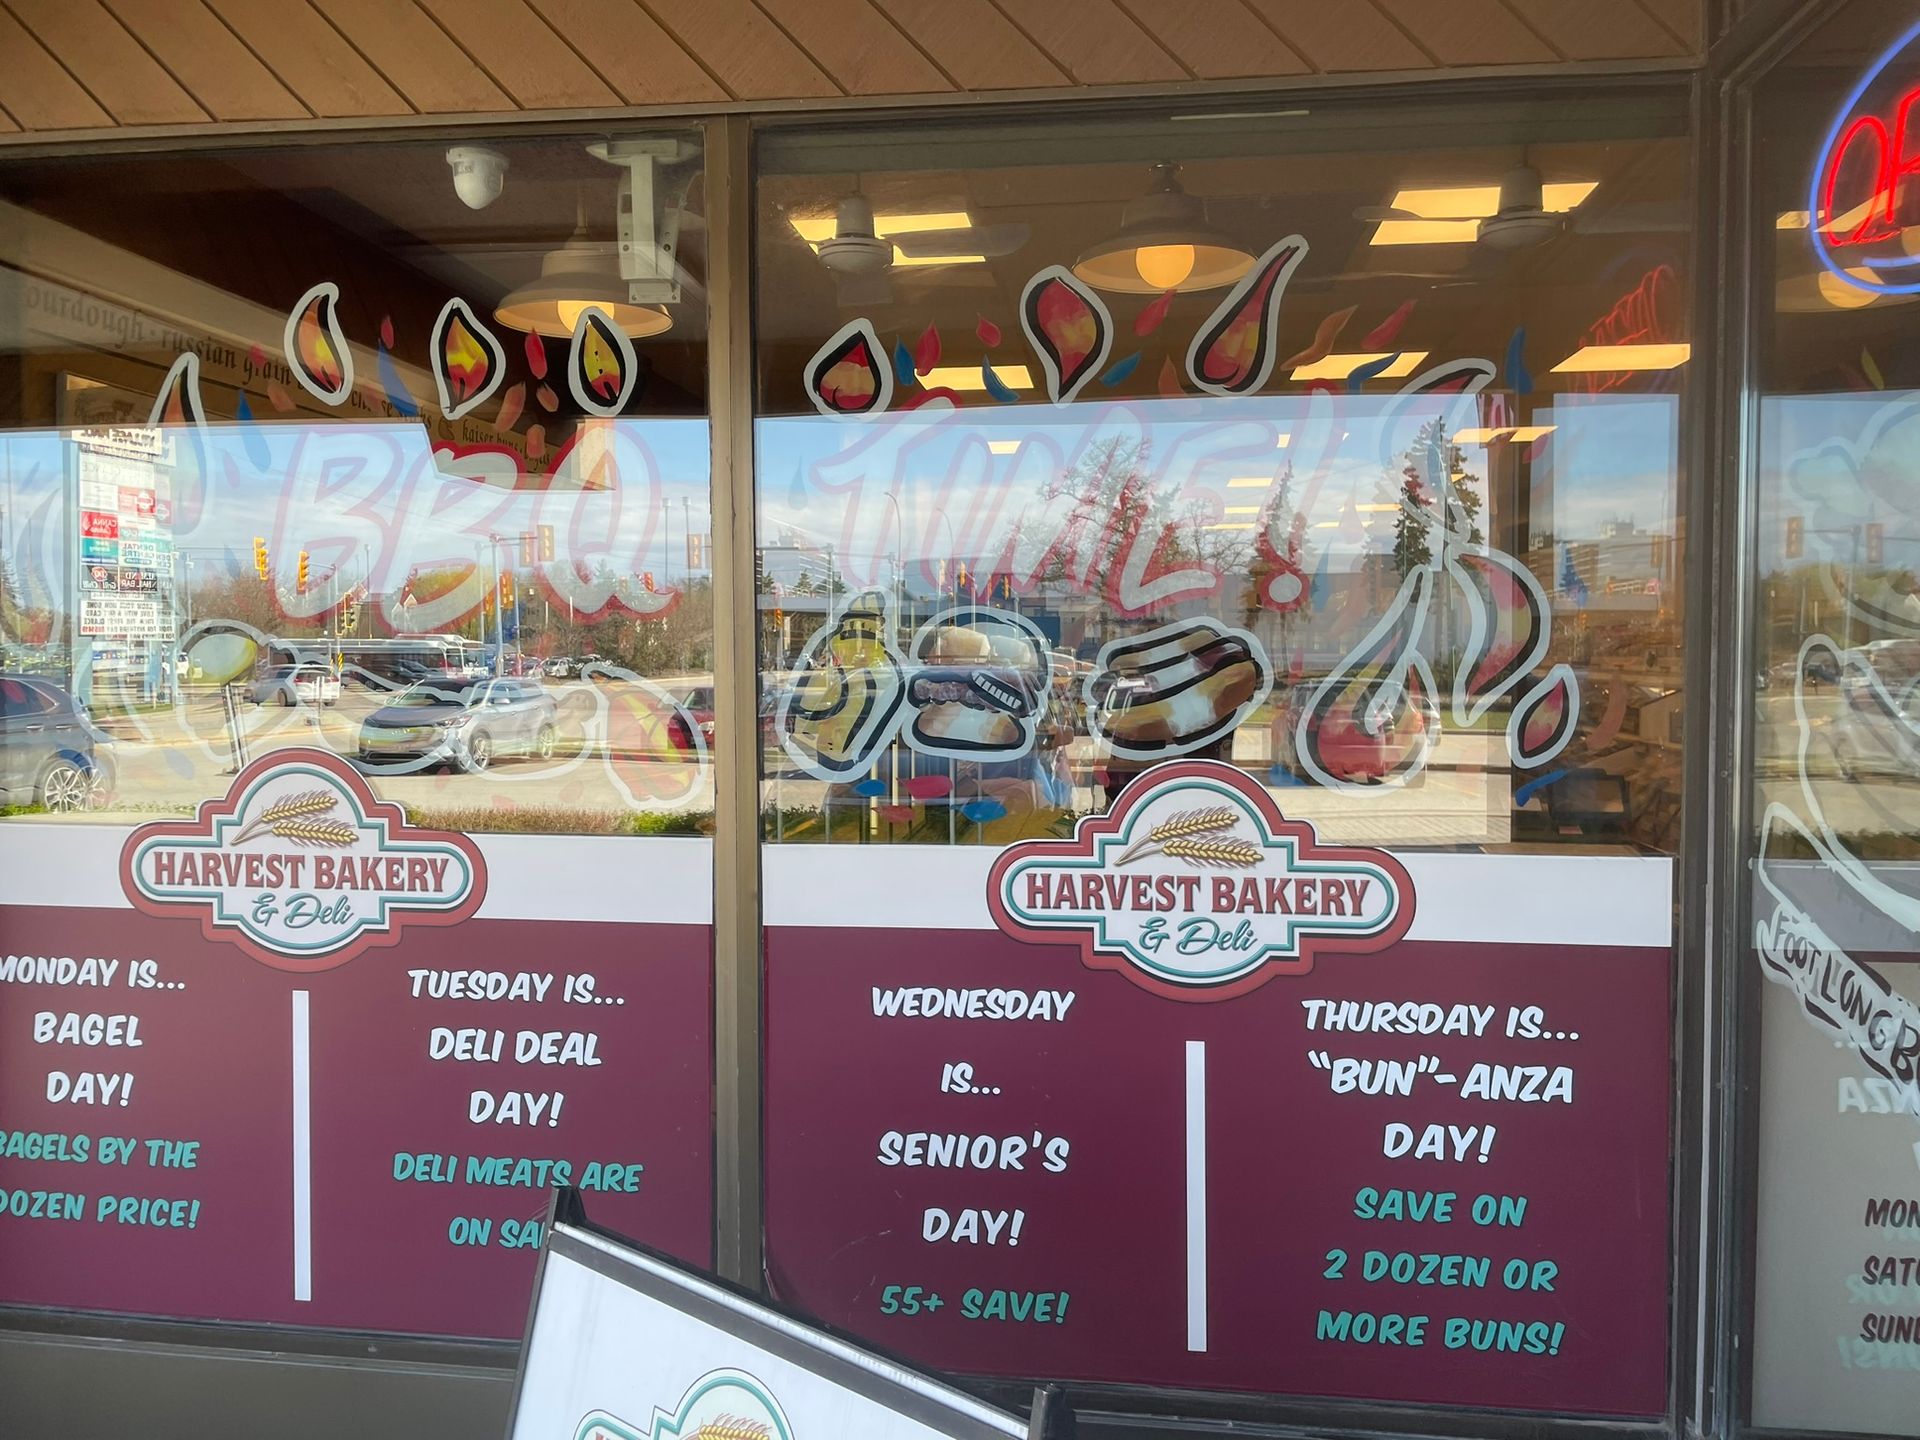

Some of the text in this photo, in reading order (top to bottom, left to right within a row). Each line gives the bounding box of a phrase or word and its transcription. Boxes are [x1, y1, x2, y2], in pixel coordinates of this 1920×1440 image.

[267, 379, 1347, 636] BBQ TIME!
[154, 851, 449, 892] HARVEST BAKERY
[252, 892, 354, 928] & Deli
[1026, 873, 1370, 916] HARVEST BAKERY
[1139, 917, 1257, 955] & Deli
[0, 955, 186, 990] MONDAY IS...
[407, 969, 625, 1005] TUESDAY IS...
[872, 986, 1076, 1022] WEDNESDAY
[1302, 999, 1580, 1041] THURSDAY IS...
[33, 1011, 143, 1047] BAGEL
[429, 1027, 602, 1066] DELI DEAL
[46, 1071, 135, 1107] DAY!
[941, 1062, 1001, 1095] IS...
[469, 1090, 564, 1128] DAY!
[98, 1136, 137, 1165] BY
[146, 1139, 200, 1169] THE
[877, 1130, 1070, 1173] SENIOR'S
[1383, 1122, 1496, 1165] DAY!
[393, 1152, 643, 1193] DELI MEATS ARE
[97, 1195, 200, 1229] PRICE!
[922, 1207, 1025, 1246] DAY!
[1355, 1187, 1528, 1228] SAVE ON
[449, 1217, 547, 1249] ON SA
[1323, 1249, 1558, 1293] 2 DOZEN OR
[881, 1285, 1070, 1323] 55+ SAVE!
[1316, 1310, 1566, 1356] MORE BUNS!
